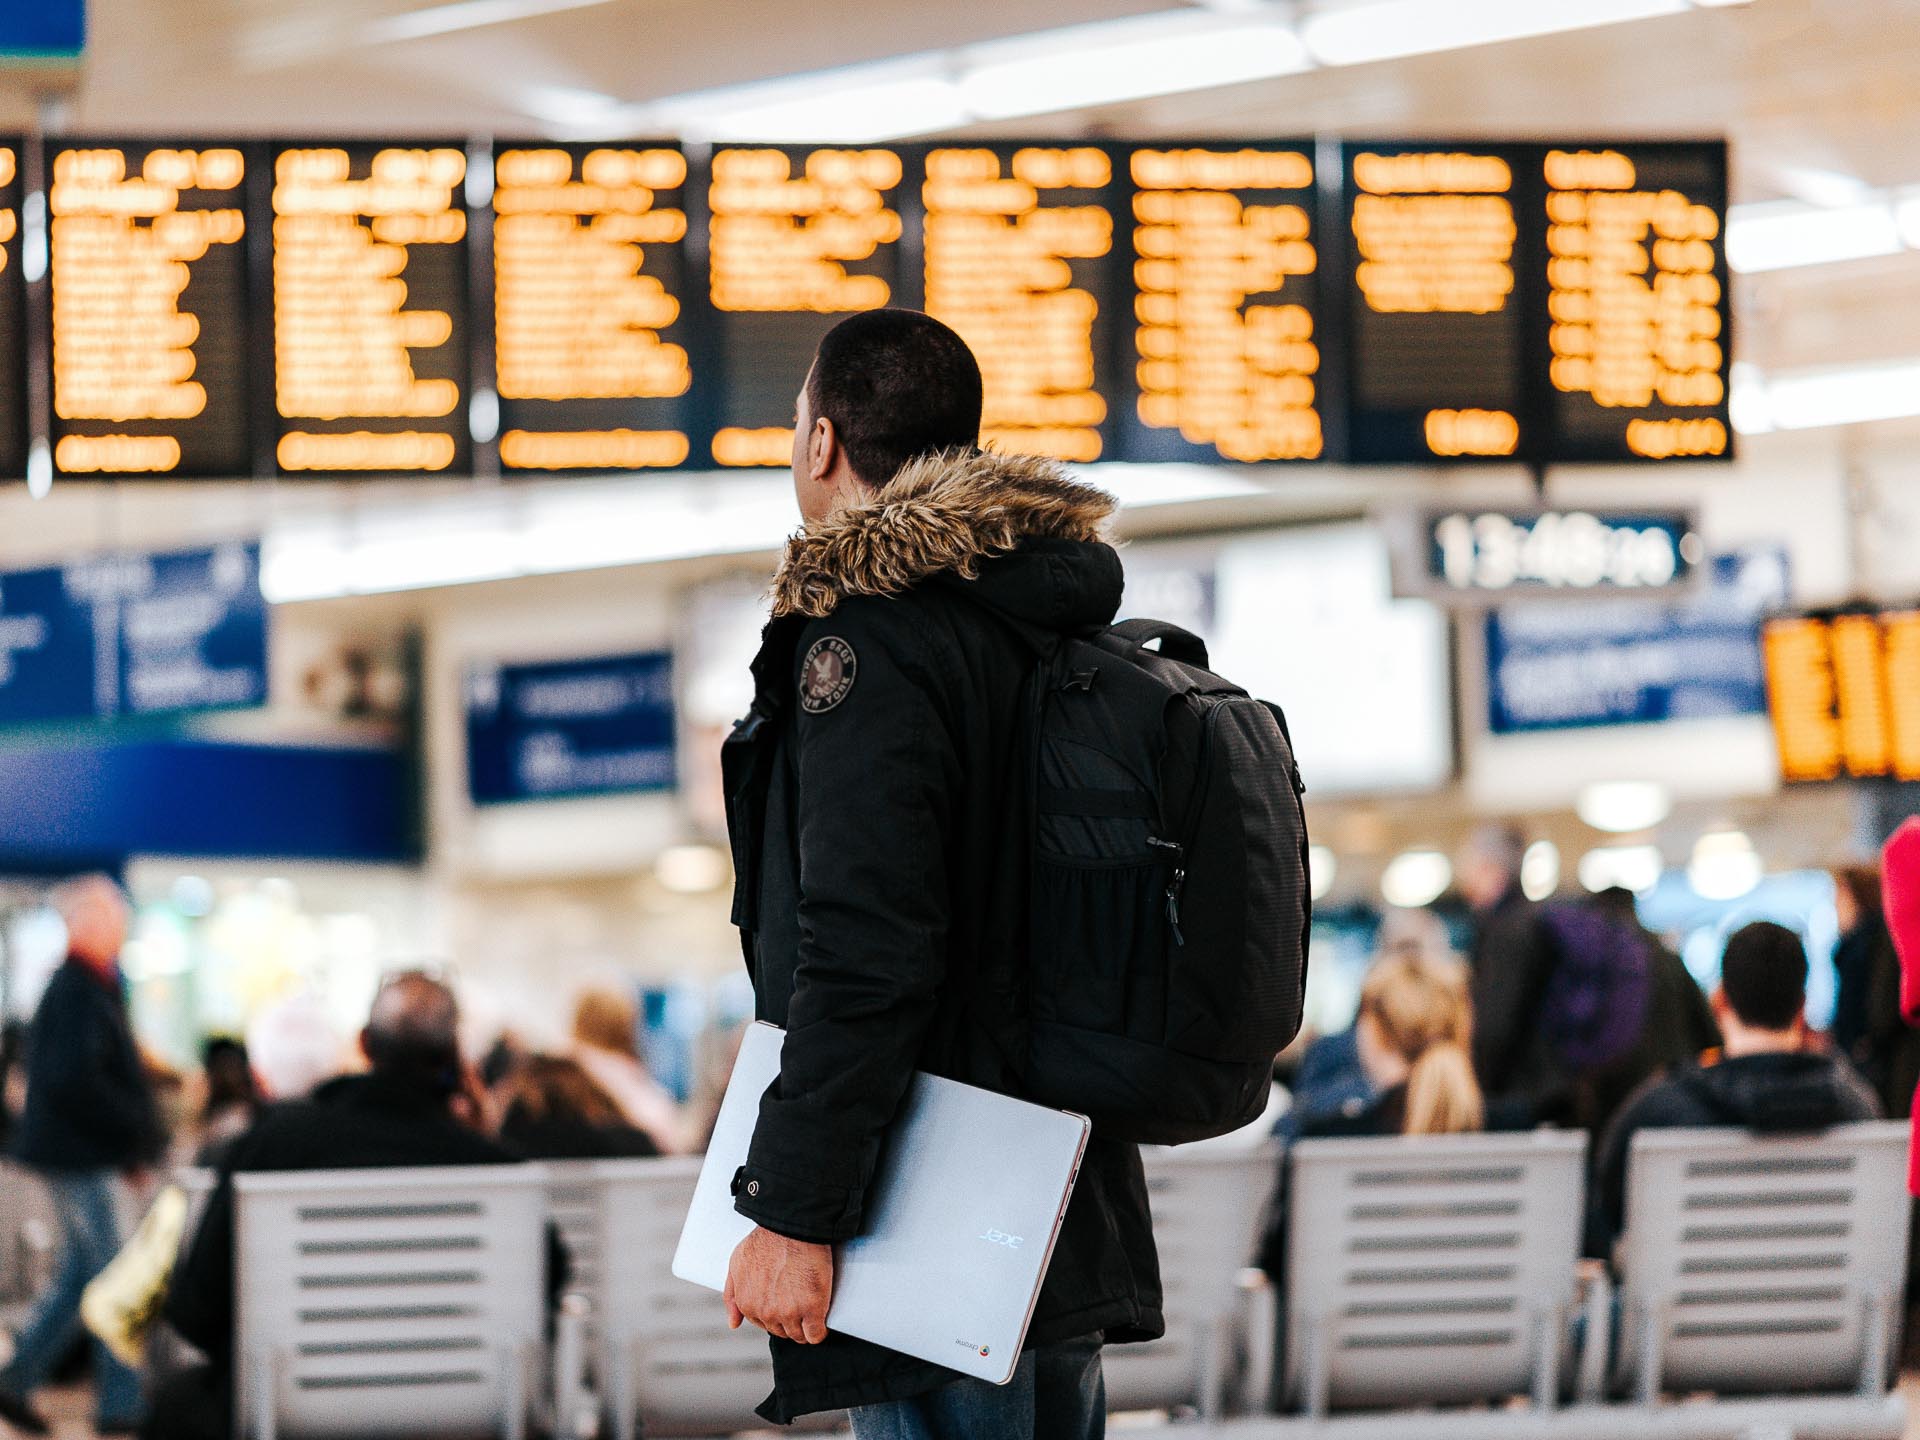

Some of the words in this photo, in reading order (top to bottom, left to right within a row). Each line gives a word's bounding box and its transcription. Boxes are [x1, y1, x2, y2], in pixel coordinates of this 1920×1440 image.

[829, 641, 851, 663] BROS
[826, 677, 850, 703] YORK
[979, 1228, 1023, 1248] acer
[955, 1336, 978, 1350] chrome
